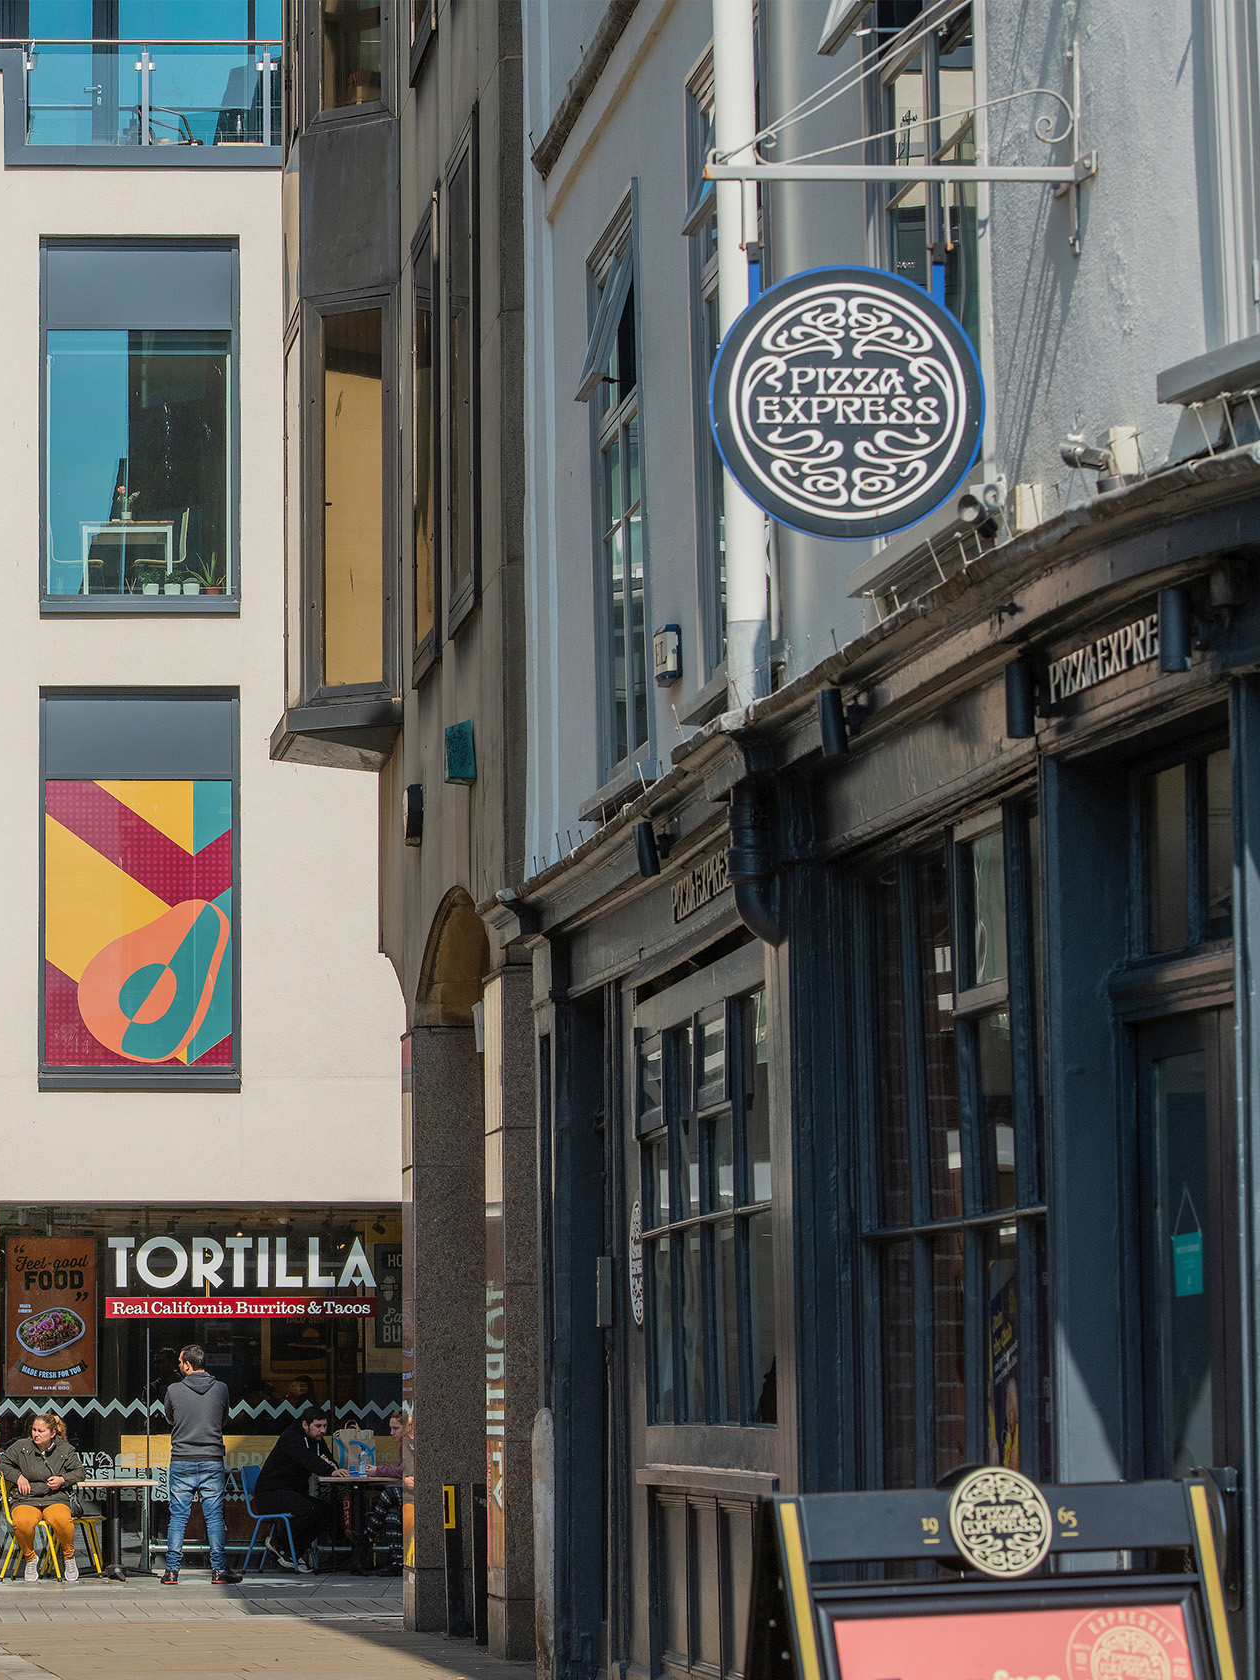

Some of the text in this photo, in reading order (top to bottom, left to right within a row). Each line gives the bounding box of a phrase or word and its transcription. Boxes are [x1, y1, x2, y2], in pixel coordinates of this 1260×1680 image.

[789, 366, 906, 395] PIZZA
[756, 396, 940, 425] EXPRESS
[15, 1255, 88, 1272] Feel-good
[108, 1236, 377, 1289] TORTILLA
[387, 1254, 403, 1267] HO
[24, 1270, 84, 1291] FOOD
[112, 1301, 371, 1315] Real California Burritos & Tacos
[21, 1365, 82, 1379] MADE FRESH FOR YOU
[920, 1505, 1078, 1536] 19 65
[975, 1504, 1024, 1521] PIZZA
[962, 1517, 1041, 1536] EXPRESS
[1088, 1610, 1175, 1645] EXPRESSLY
